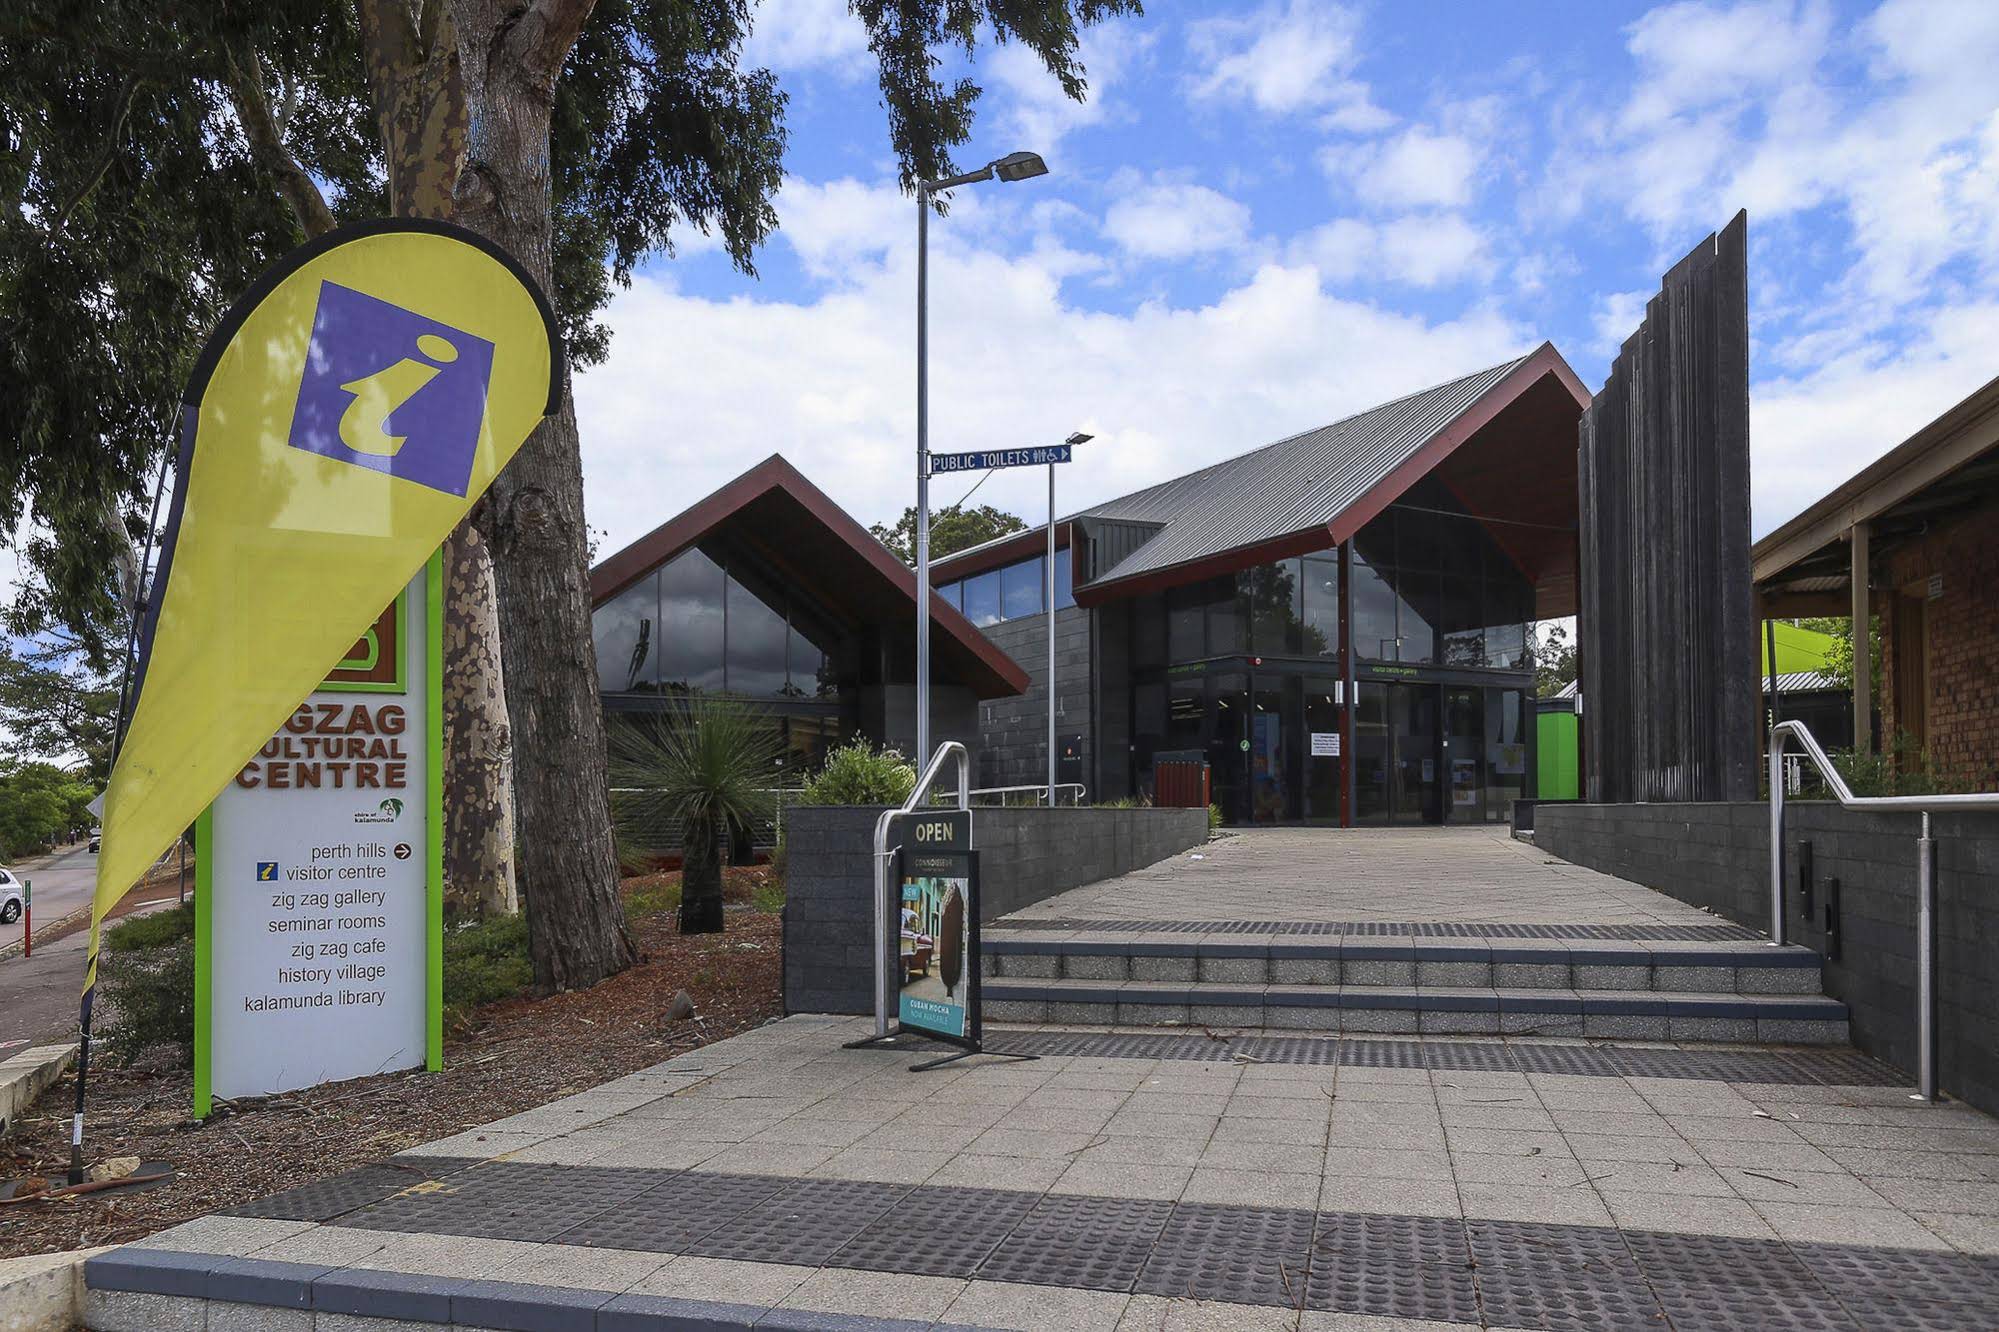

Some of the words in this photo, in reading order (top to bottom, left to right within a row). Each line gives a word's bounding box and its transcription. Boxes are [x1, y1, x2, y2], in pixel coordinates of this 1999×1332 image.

[932, 454, 976, 471] PUBLIC
[981, 450, 1029, 467] TOILETS
[284, 703, 406, 735] GZAG
[260, 737, 407, 760] ULTURAL
[235, 761, 407, 789] CENTRE
[915, 822, 953, 842] OPEN
[312, 843, 351, 862] perth
[357, 843, 386, 858] hills
[286, 865, 333, 881] visitor
[338, 864, 386, 879] centre
[272, 891, 295, 910] zig
[301, 894, 329, 909] zag
[334, 889, 386, 908] gallery
[268, 916, 333, 933] seminar
[338, 915, 386, 929] rooms
[291, 941, 315, 960] zig
[319, 942, 348, 958] zag
[353, 937, 386, 954] cafe
[278, 968, 332, 985] history
[336, 964, 386, 982] village
[245, 991, 333, 1012] kalamunda
[338, 990, 386, 1007] library
